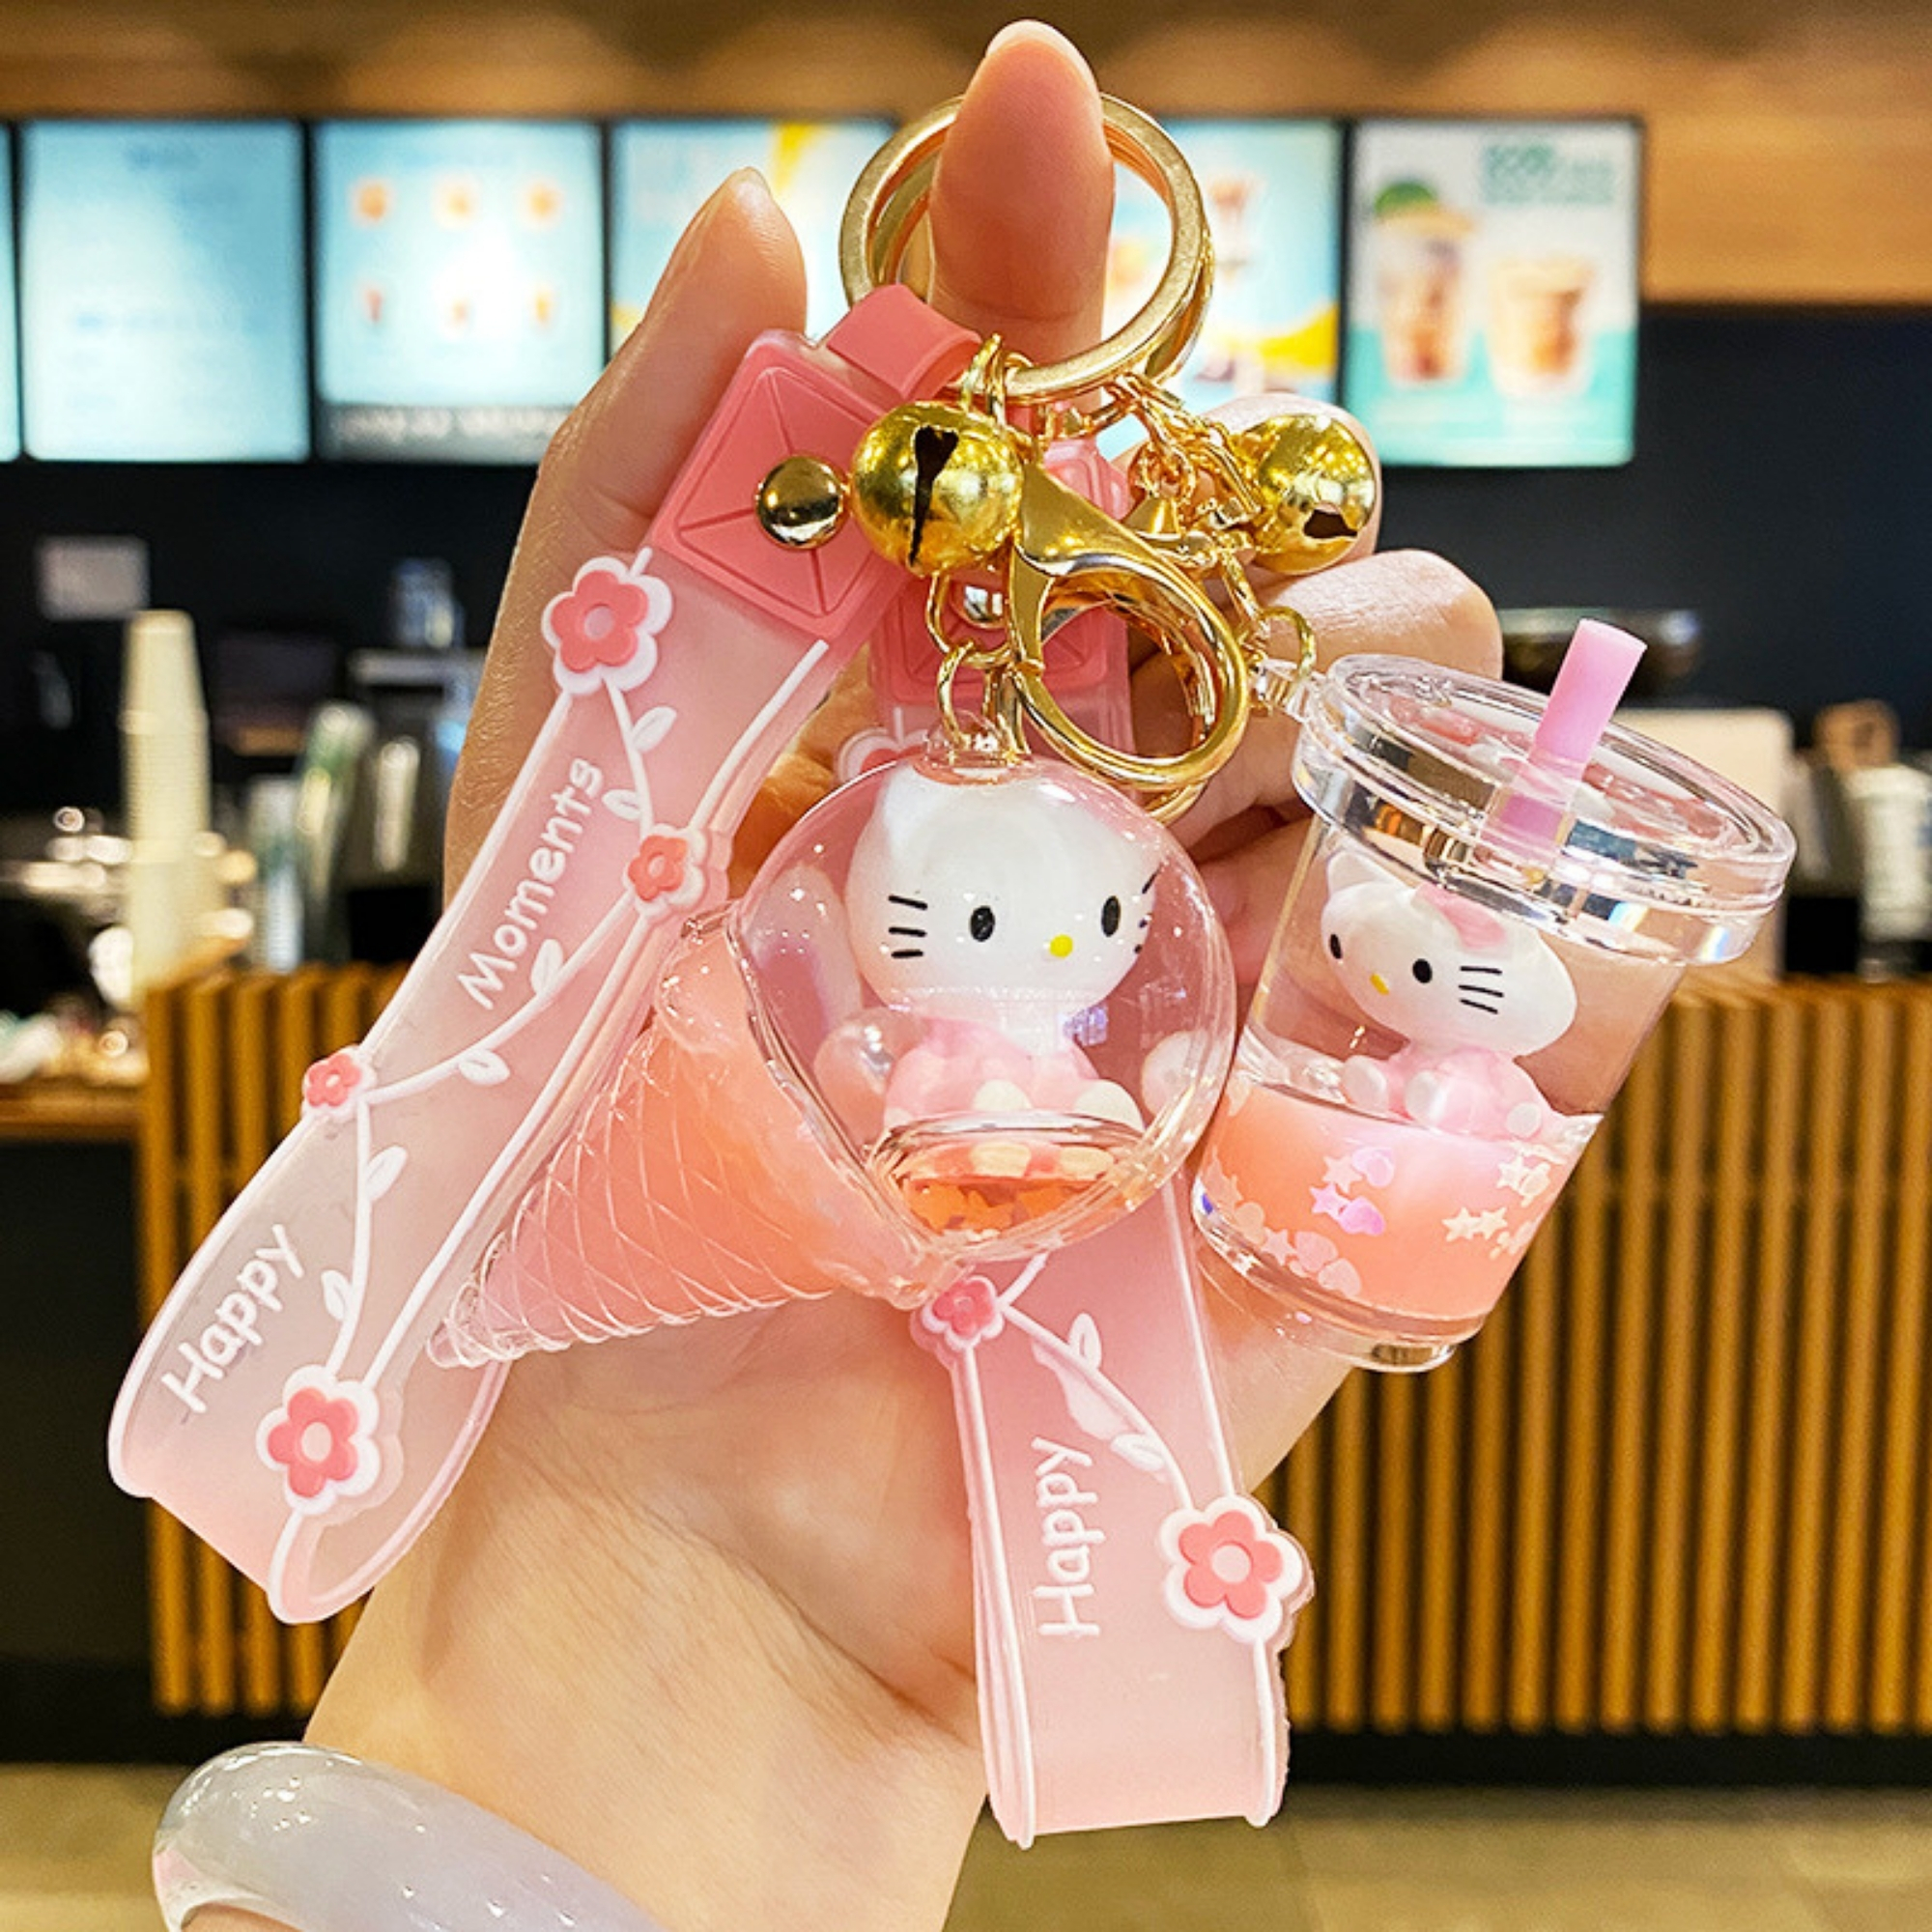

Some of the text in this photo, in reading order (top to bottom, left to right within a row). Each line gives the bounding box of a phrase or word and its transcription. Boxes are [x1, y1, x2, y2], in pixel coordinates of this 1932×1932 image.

[162, 757, 604, 1413] Happy Moments
[1033, 1436, 1105, 1636] Happy
